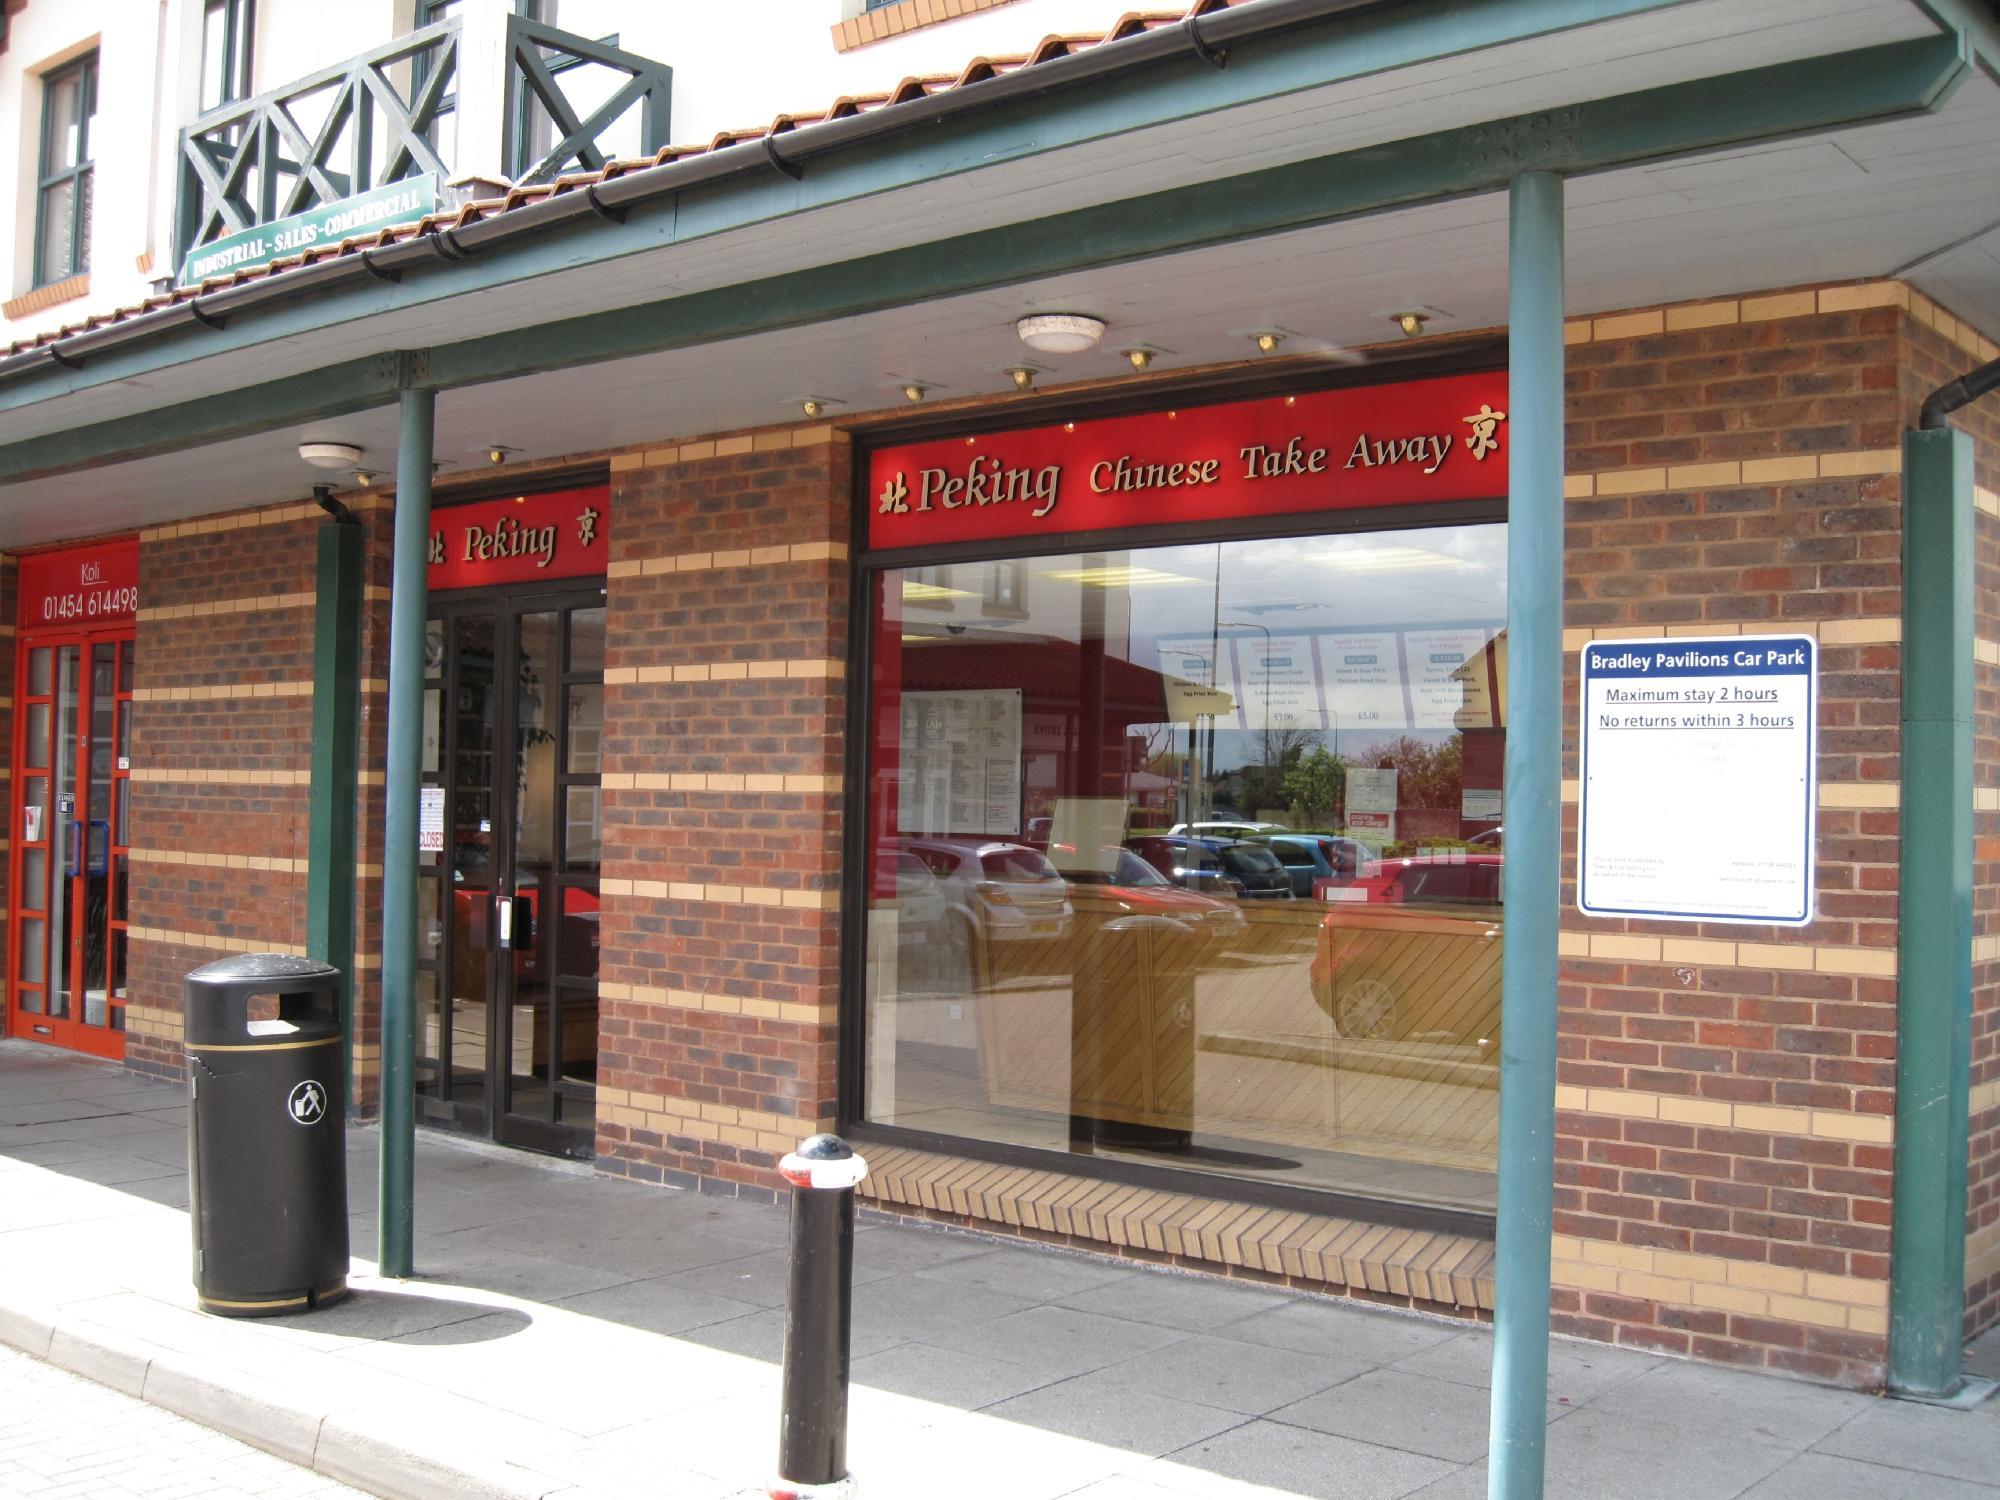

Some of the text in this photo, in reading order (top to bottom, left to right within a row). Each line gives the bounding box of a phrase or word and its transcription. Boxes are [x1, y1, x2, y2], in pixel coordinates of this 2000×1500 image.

[274, 223, 317, 252] SALES
[878, 404, 1506, 517] 北 Peking Chinese Take Away 京
[461, 516, 556, 568] Peking
[576, 507, 598, 547] 京
[44, 586, 138, 620] 01454 614498
[1591, 649, 1805, 672] Bradley Pavilions Car Park
[1606, 687, 1778, 704] Maximum stay 2 hours
[1599, 713, 1794, 727] No returns within 3 hours
